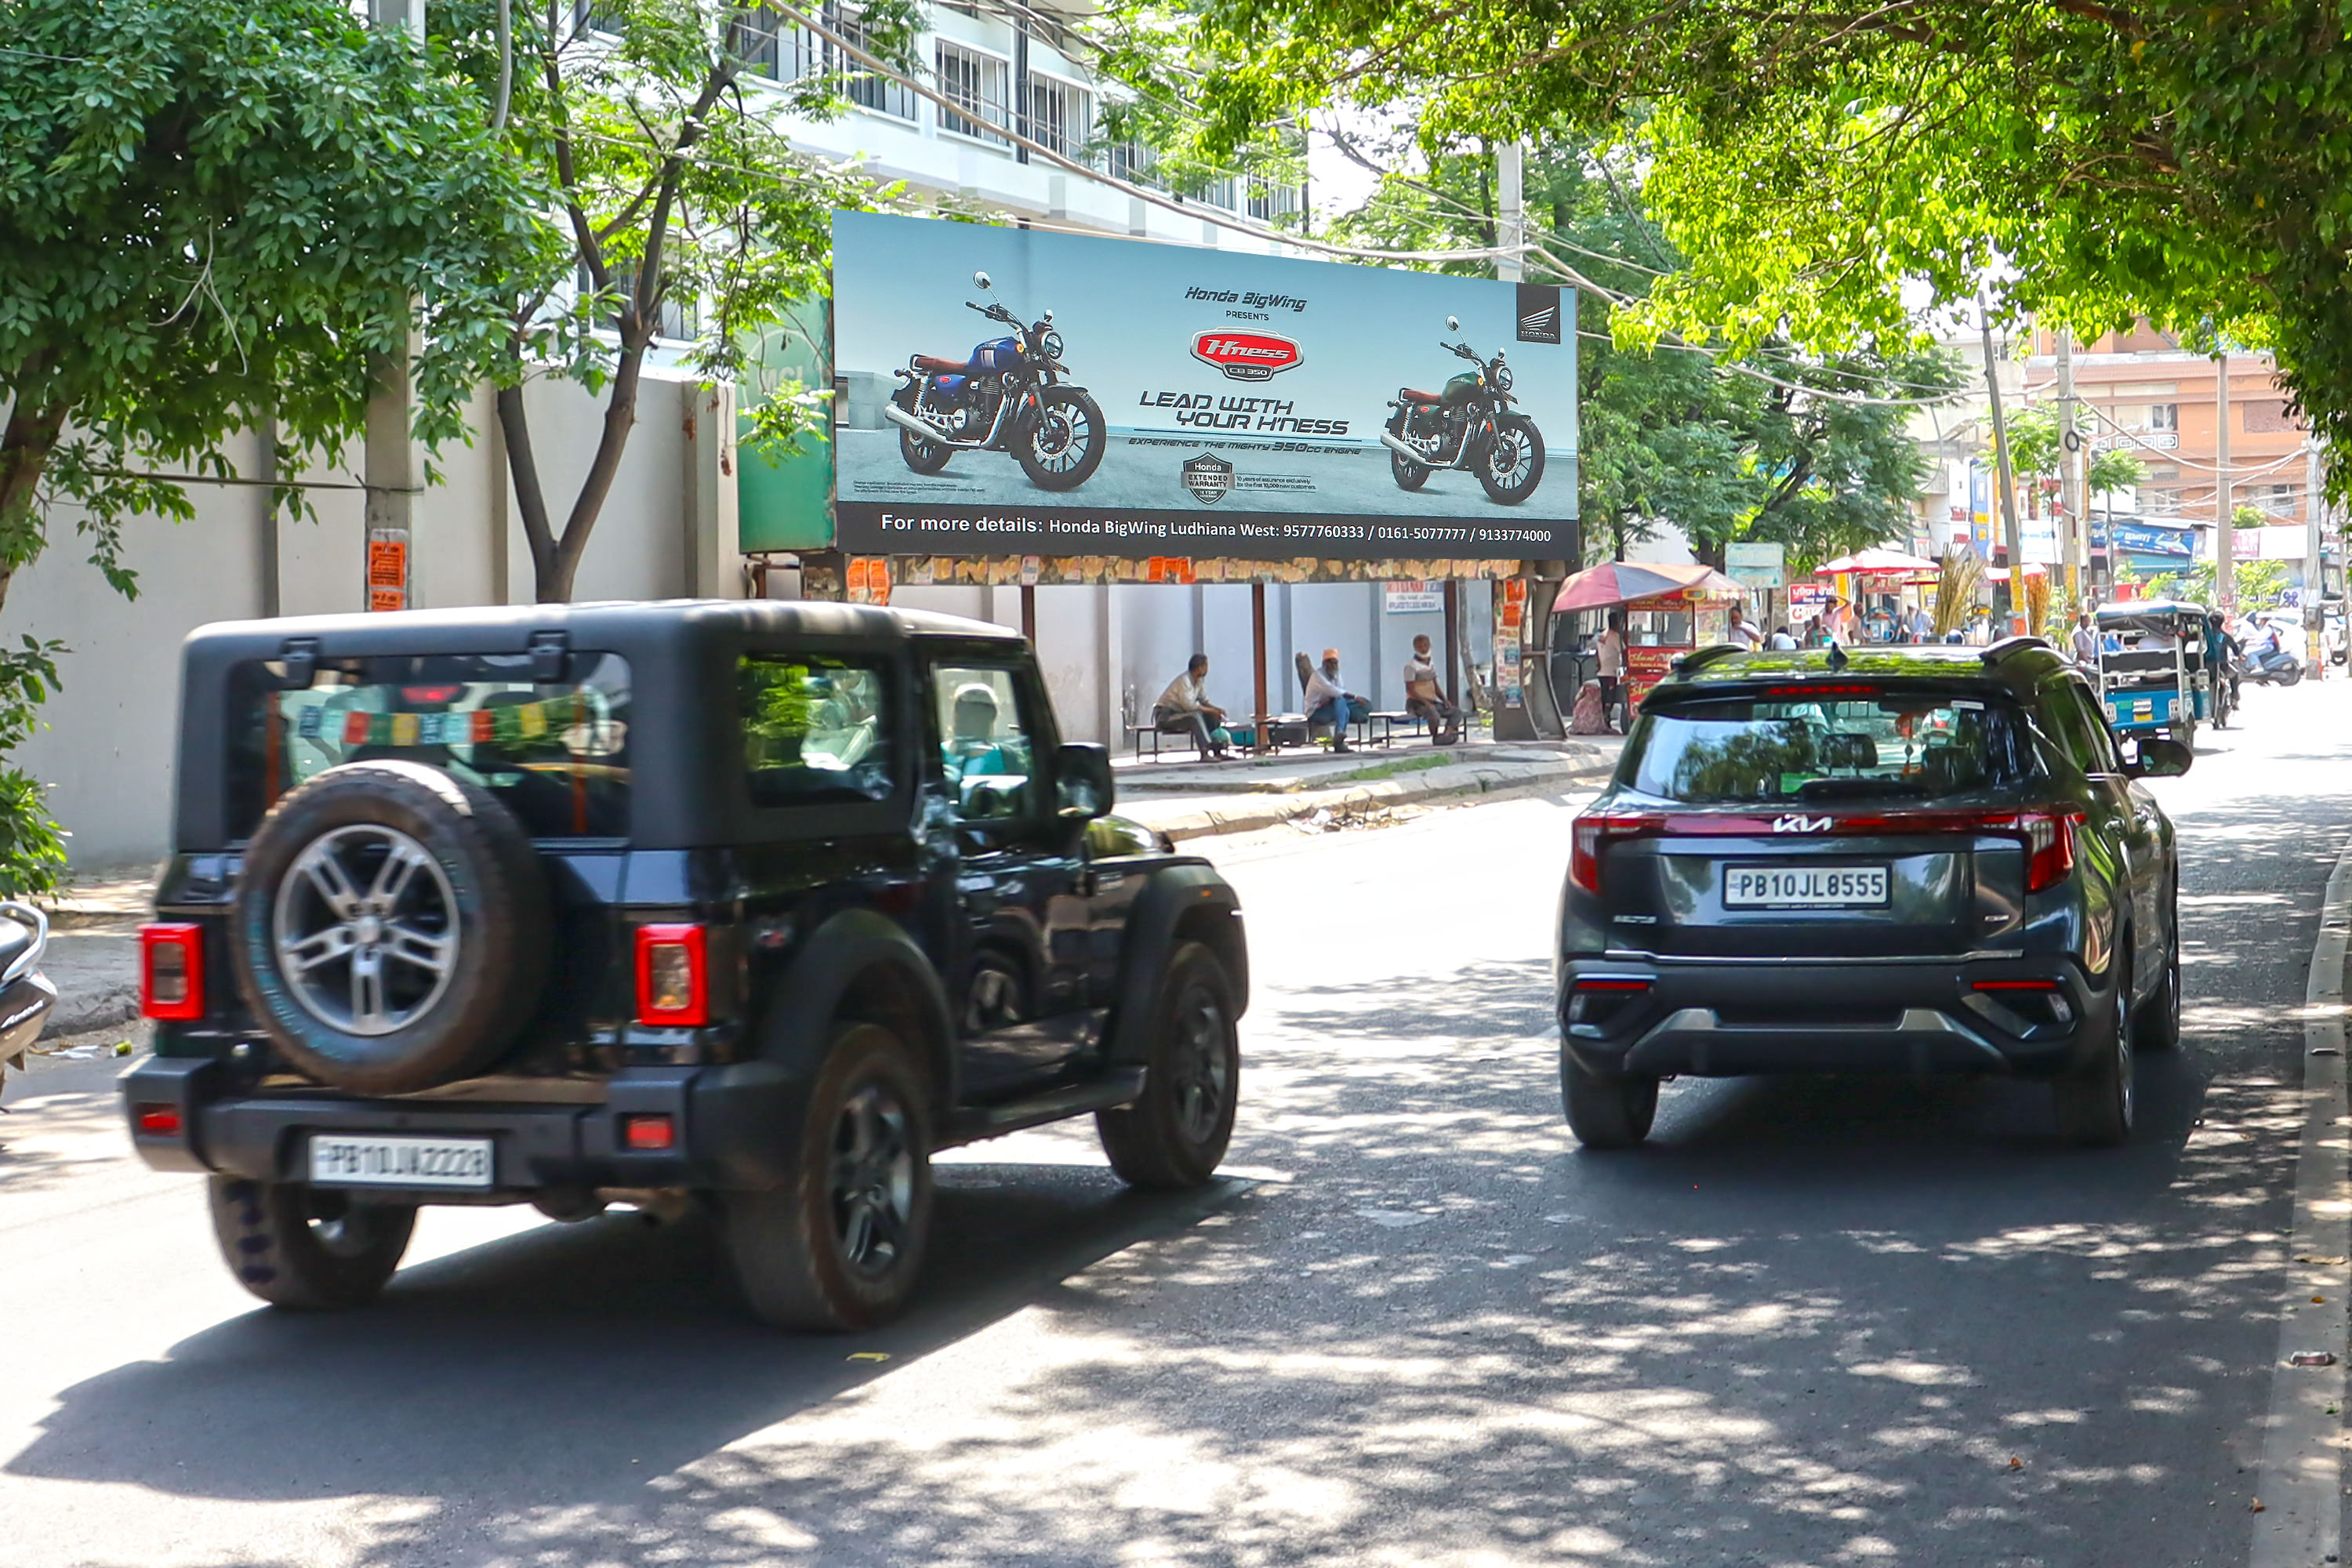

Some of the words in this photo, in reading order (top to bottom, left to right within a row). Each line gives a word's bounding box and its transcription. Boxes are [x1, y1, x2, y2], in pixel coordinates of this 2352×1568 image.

[1185, 286, 1239, 303] Honda
[1242, 292, 1307, 312] BigWing
[1226, 310, 1269, 321] PRESENTS
[1521, 330, 1556, 339] HONDA
[1205, 339, 1290, 360] H'ness
[1139, 390, 1213, 409] LEAD
[1218, 396, 1294, 415] WITH
[1176, 411, 1251, 430] YOUR
[1257, 416, 1349, 435] H'NESS
[1128, 437, 1200, 448] EXPERIENCE
[1228, 442, 1271, 451] MIGHTY
[1194, 463, 1222, 471] Honda
[880, 514, 915, 532] For
[920, 517, 971, 532] more
[975, 516, 1044, 533] details:
[1049, 519, 1100, 534] Honda
[1105, 520, 1167, 538] BigWing
[1171, 522, 1236, 537] Ludhiana
[1240, 524, 1279, 537] West:
[1283, 524, 1364, 539] 9577760333
[1367, 525, 1375, 541] /
[1377, 526, 1466, 541] 0161-5077777
[1469, 528, 1476, 543] /
[1479, 528, 1552, 543] 9133774000
[1740, 874, 1883, 898] PB10JL8555
